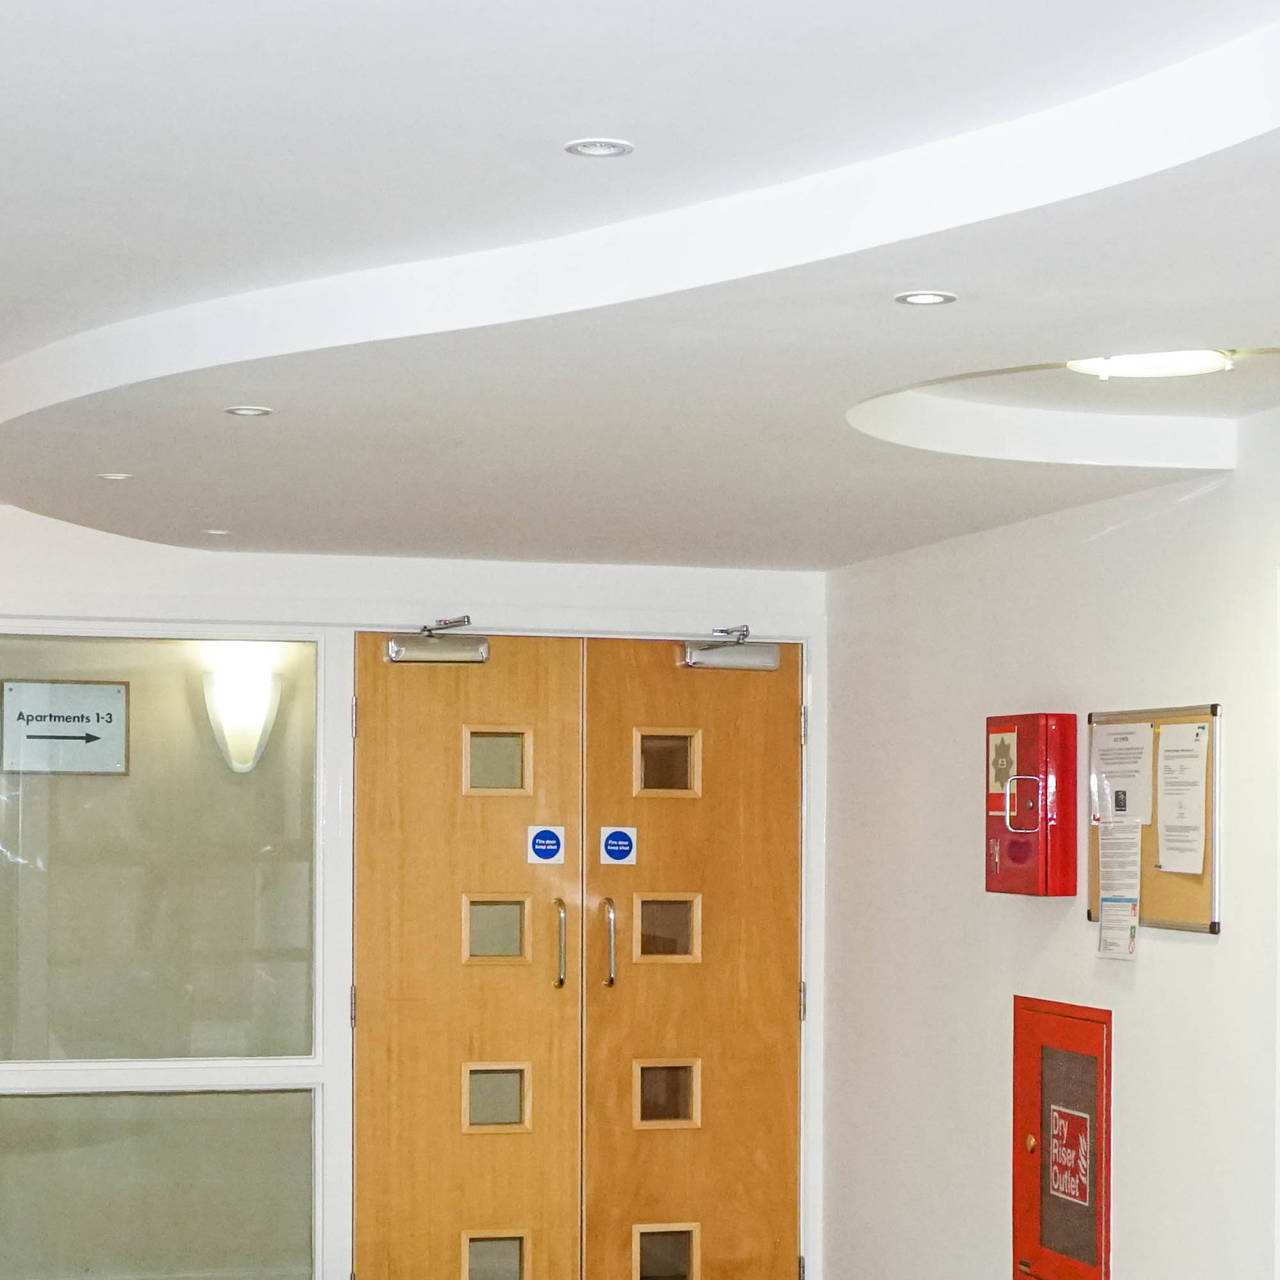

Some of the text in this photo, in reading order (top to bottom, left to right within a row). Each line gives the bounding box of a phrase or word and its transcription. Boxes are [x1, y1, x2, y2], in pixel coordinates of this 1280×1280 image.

[16, 711, 113, 726] Apartments 1-3
[1052, 1111, 1069, 1145] Dry
[1052, 1138, 1077, 1168] Riser
[1052, 1164, 1080, 1197] Outlet
